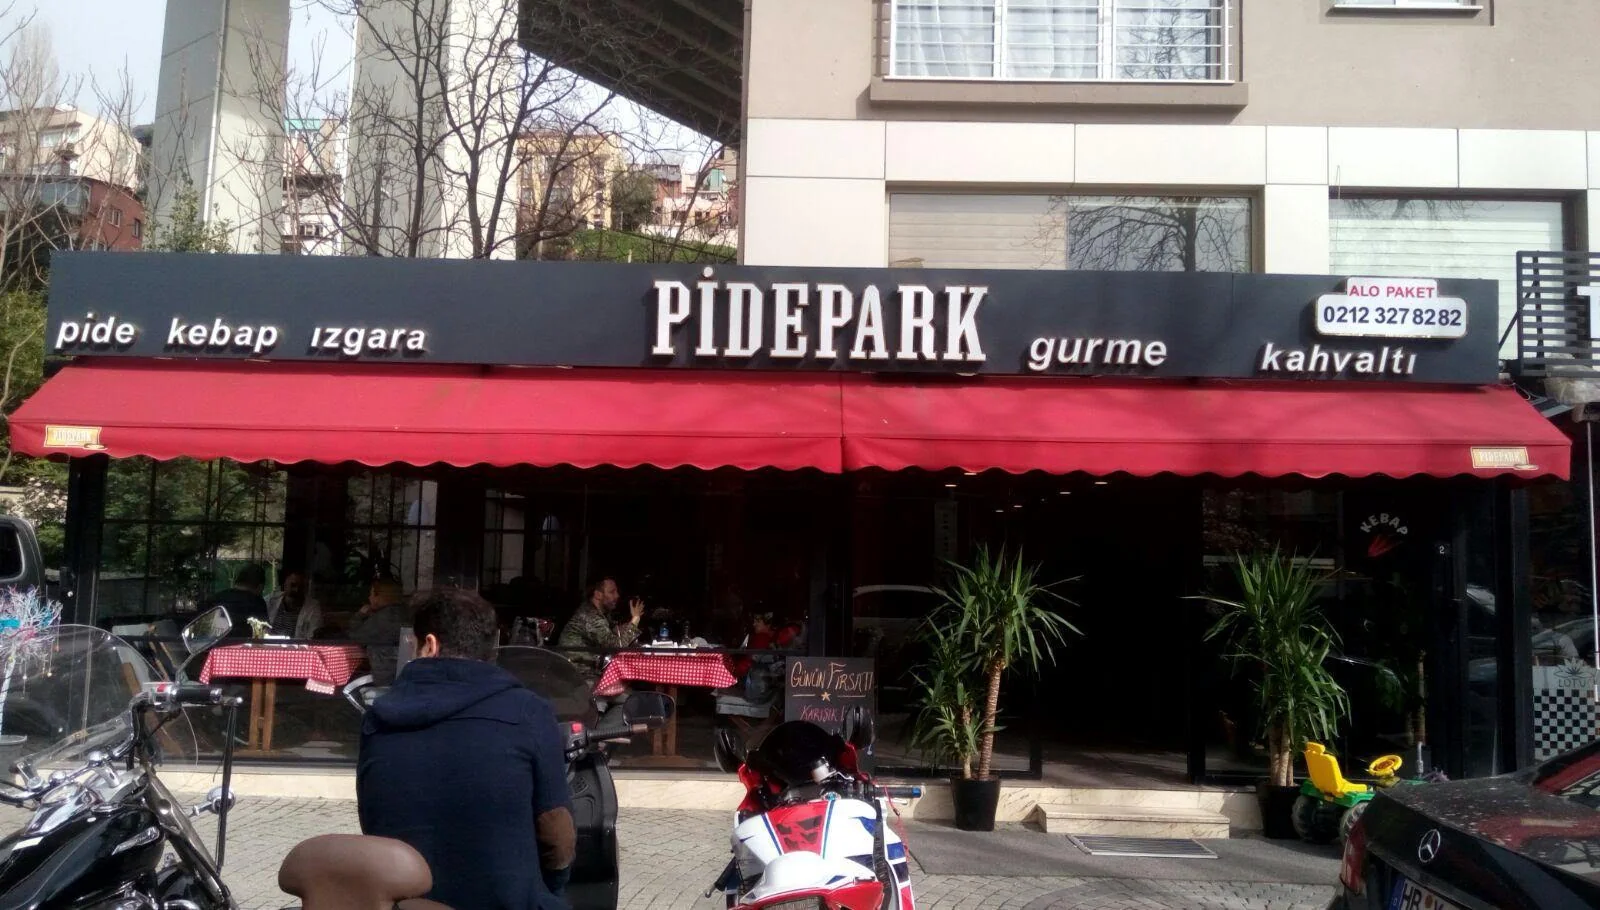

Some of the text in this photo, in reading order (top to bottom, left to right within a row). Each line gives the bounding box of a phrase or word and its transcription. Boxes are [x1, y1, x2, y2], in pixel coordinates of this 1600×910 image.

[1349, 285, 1435, 298] ALO PAKET
[1323, 306, 1370, 324] 0212
[55, 312, 136, 349] pide
[166, 317, 279, 350] kebap
[1028, 336, 1168, 371] gurme
[1360, 513, 1408, 534] KEBAP
